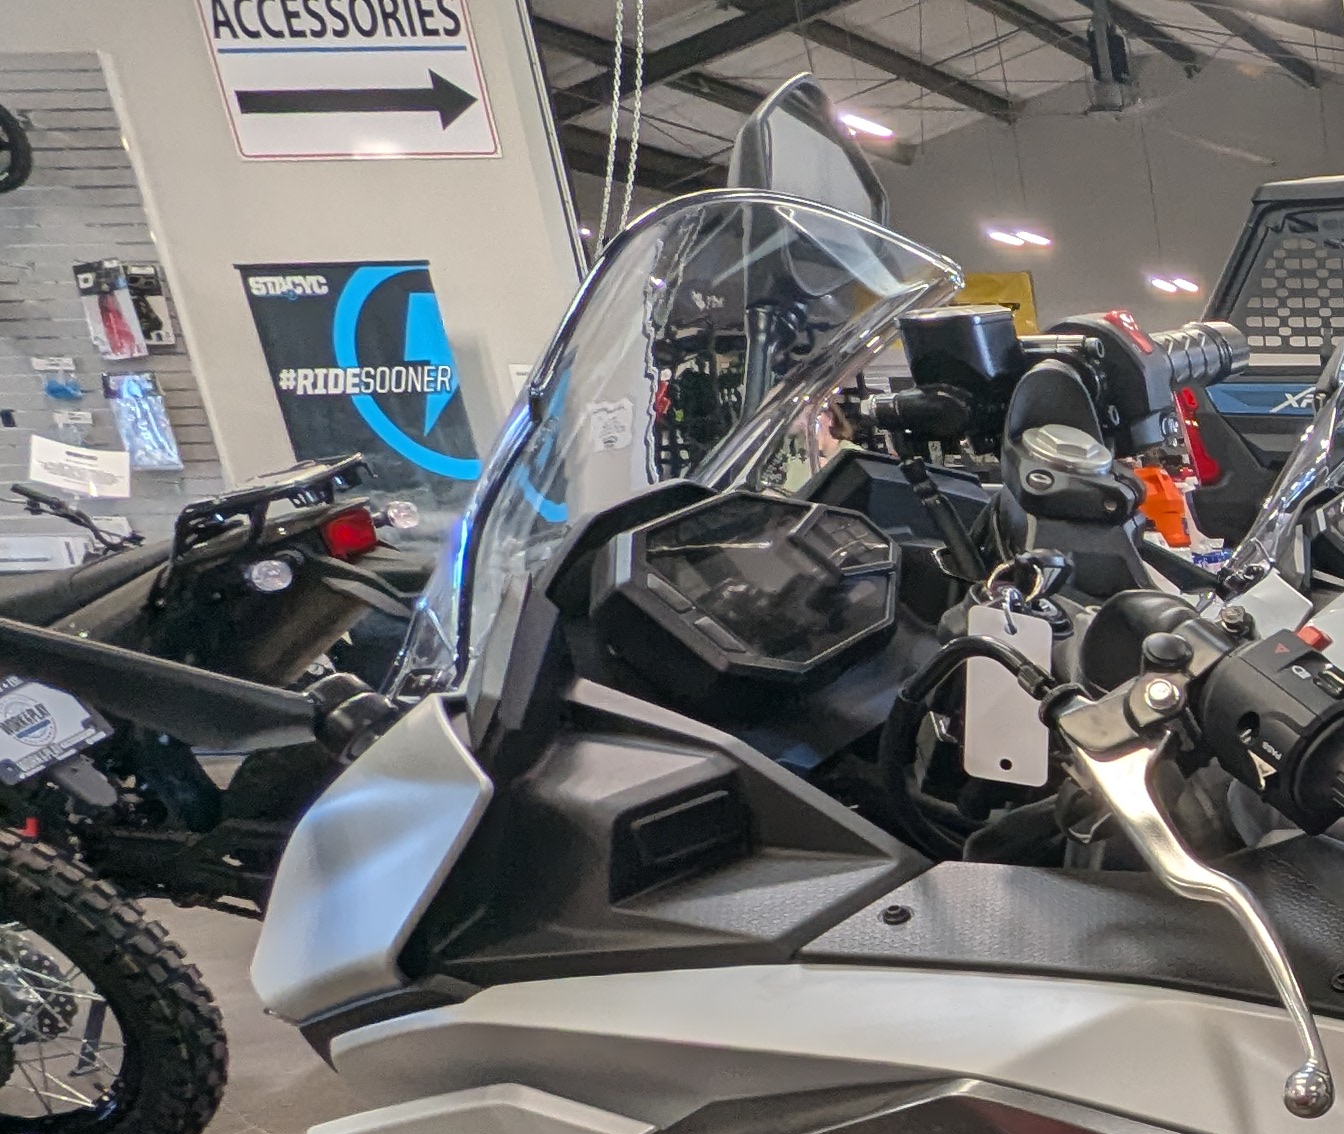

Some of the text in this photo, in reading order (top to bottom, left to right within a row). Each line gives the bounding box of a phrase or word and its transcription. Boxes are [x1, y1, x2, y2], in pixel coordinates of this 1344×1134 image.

[213, 0, 461, 39] ACCESSORIES
[249, 275, 329, 296] STACYC
[279, 365, 451, 395] #RIDESOONER
